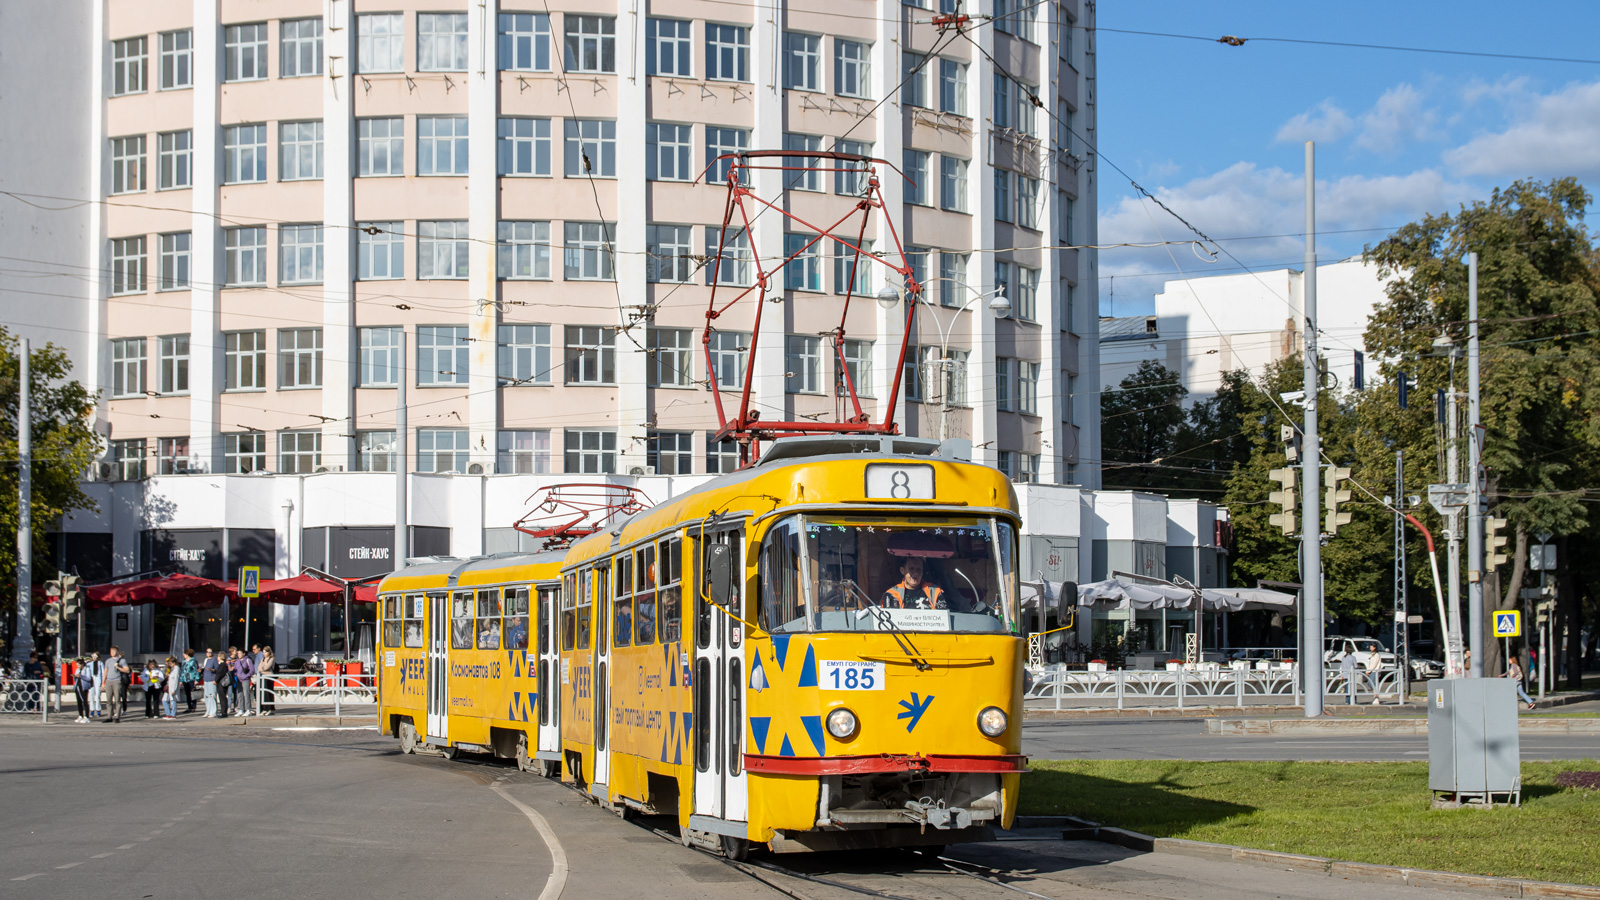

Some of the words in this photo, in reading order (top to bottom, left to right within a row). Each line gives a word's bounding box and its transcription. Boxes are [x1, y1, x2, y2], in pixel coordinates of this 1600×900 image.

[891, 470, 911, 498] 8
[169, 547, 206, 561] СТЕЙК-ХАУС
[349, 546, 389, 560] СТЕЙК-ХАУС
[1048, 554, 1061, 566] Si!
[878, 610, 894, 630] 8
[400, 658, 425, 683] VEER
[450, 660, 488, 679] Космонавтов
[489, 661, 501, 680] 108
[829, 667, 875, 690] 185
[407, 685, 425, 696] MALL
[573, 666, 592, 702] VEER
